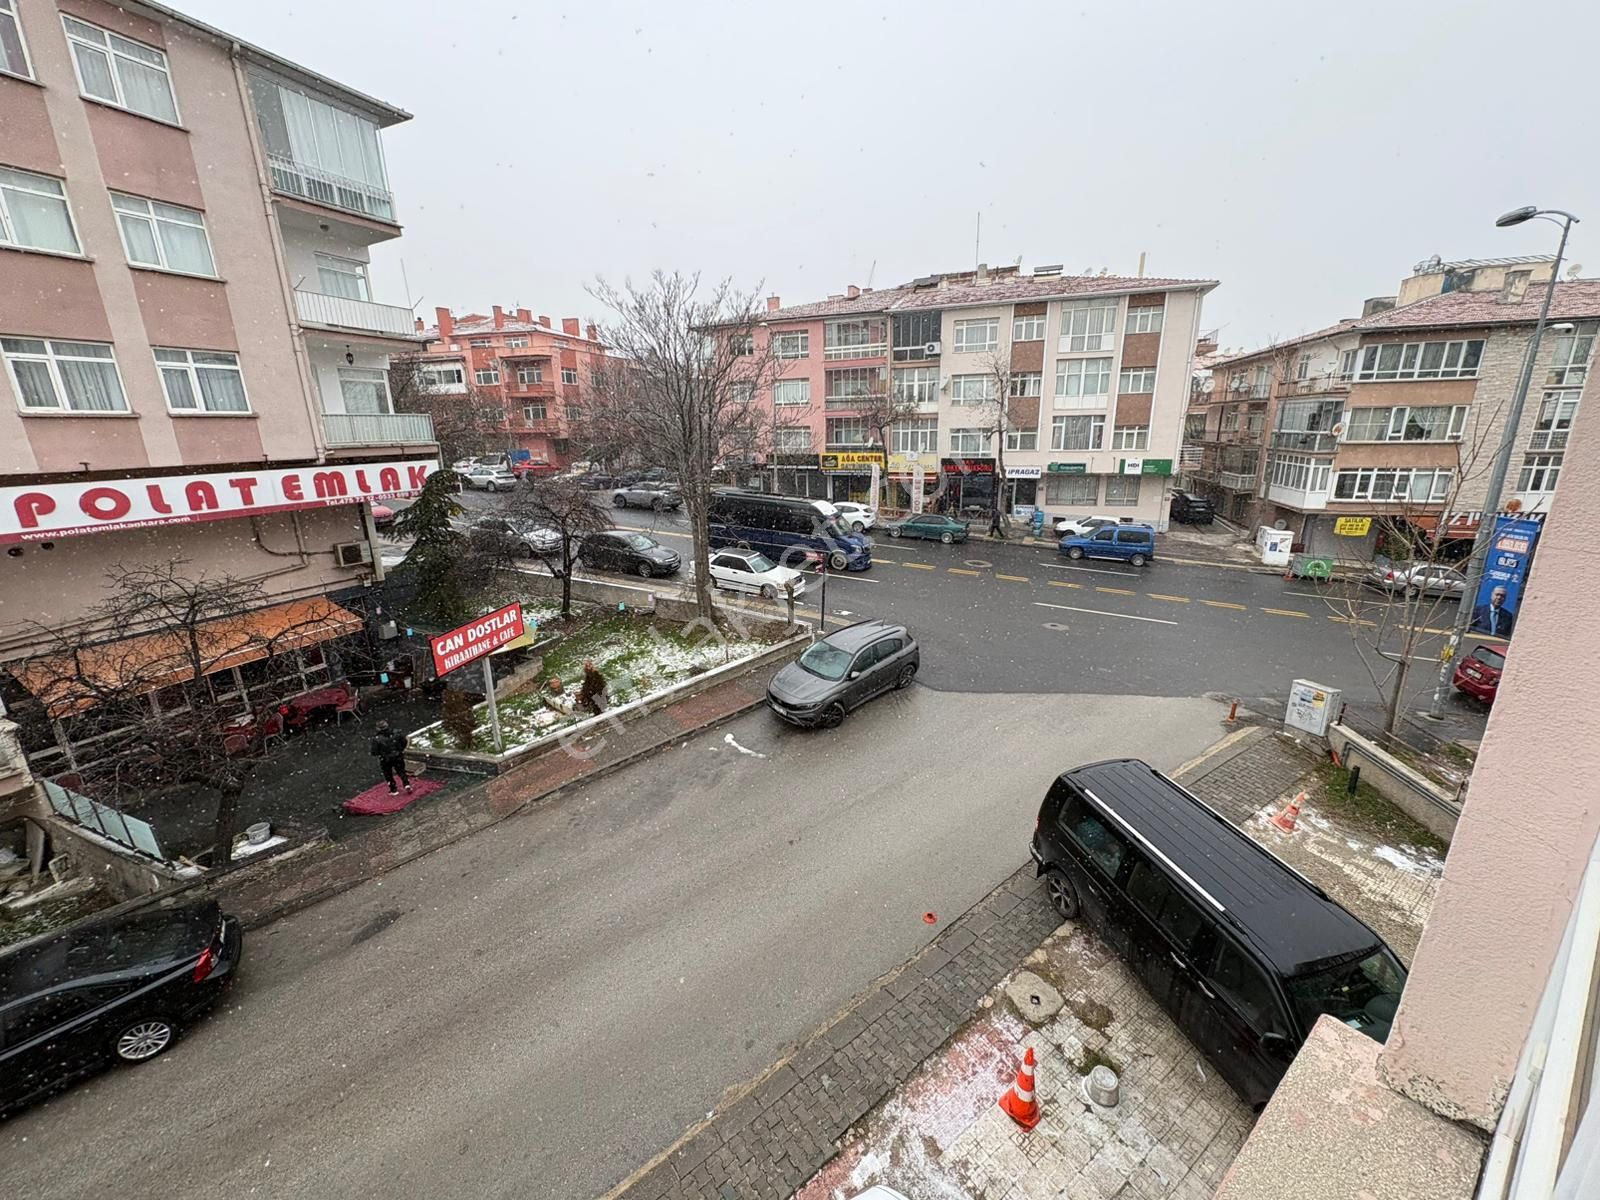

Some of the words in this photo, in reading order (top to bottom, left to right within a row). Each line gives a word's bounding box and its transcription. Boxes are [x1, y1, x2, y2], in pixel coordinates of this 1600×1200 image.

[857, 455, 883, 463] CENTER
[14, 477, 258, 528] POLAT
[281, 465, 428, 500] EMLAK
[20, 515, 191, 541] www.polatemlakankara.com
[436, 633, 464, 656] CAN
[467, 609, 517, 642] DOSTLAR
[444, 639, 491, 669] KIRAATHANE
[500, 626, 515, 642] CAFE
